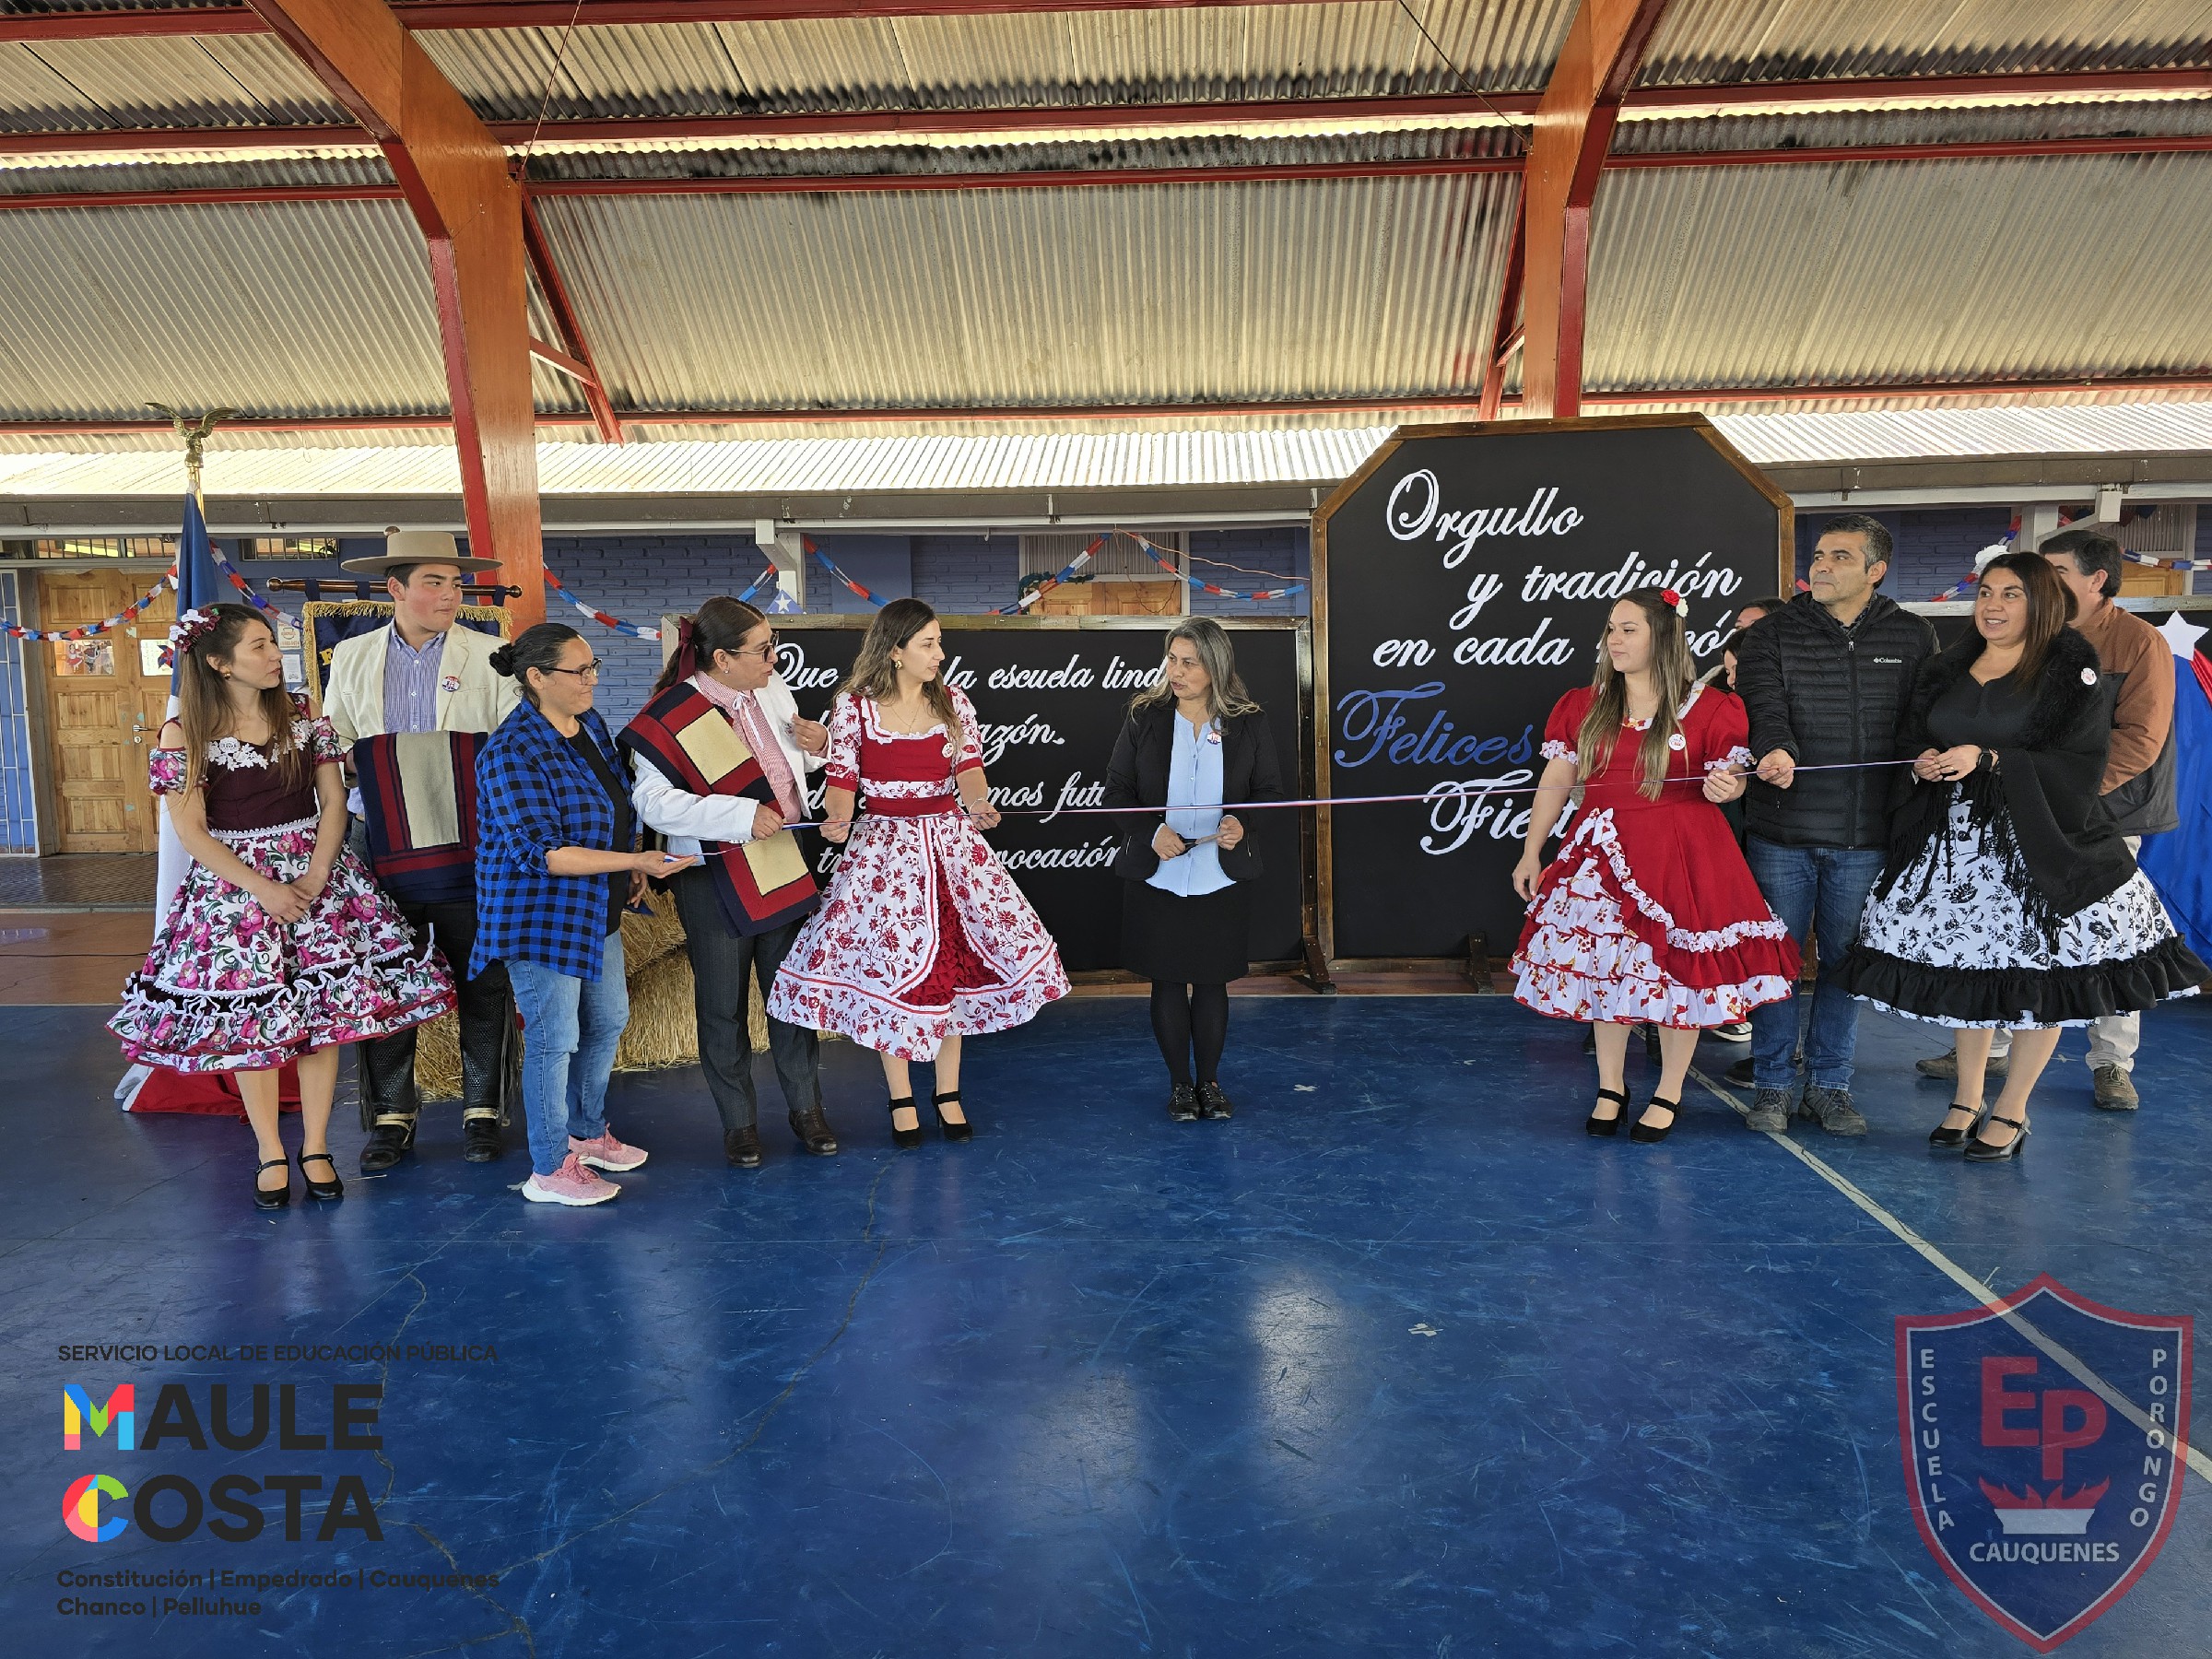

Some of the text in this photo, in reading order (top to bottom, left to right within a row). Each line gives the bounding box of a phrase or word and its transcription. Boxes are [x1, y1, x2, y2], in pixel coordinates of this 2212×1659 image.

[1386, 469, 1584, 569] Orgullo
[1449, 551, 1742, 630] y tradición
[774, 642, 1169, 691] Que la escuela lind
[1372, 638, 1436, 667] en
[1453, 618, 1575, 665] cada
[1335, 681, 1534, 768] Felices
